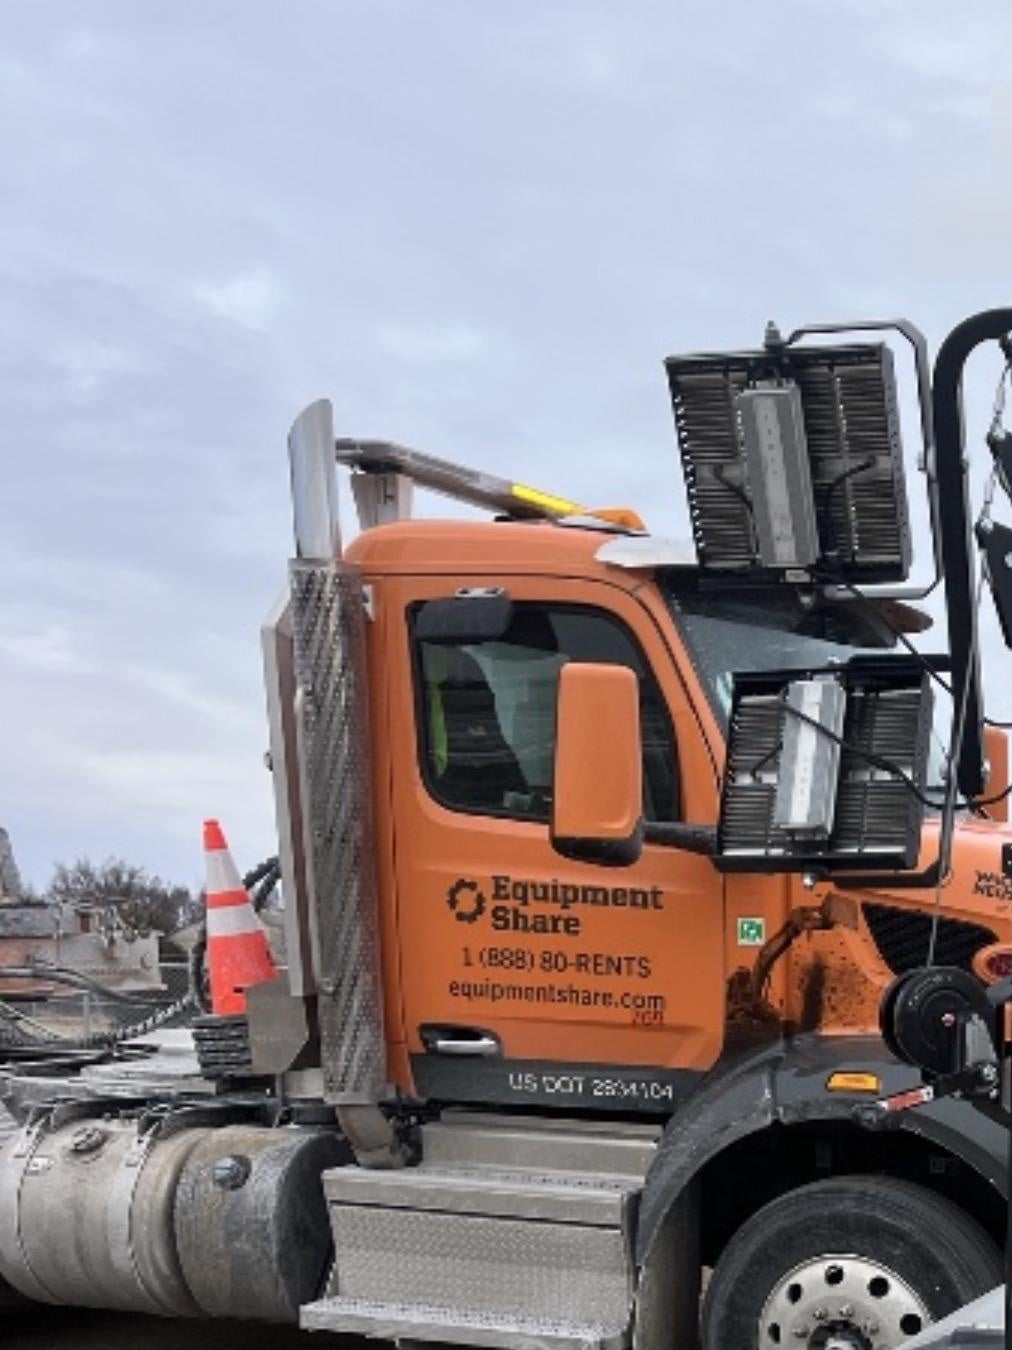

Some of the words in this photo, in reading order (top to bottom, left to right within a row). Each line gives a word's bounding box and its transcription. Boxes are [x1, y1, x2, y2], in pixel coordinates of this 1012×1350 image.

[491, 875, 664, 911] Equipment
[491, 905, 580, 936] Share
[461, 947, 474, 967] 1
[479, 947, 535, 971] (888)
[540, 951, 651, 979] 80-RENTS
[449, 978, 665, 1010] equipmentshare.com
[508, 1072, 538, 1093] US
[542, 1075, 586, 1095] DOT
